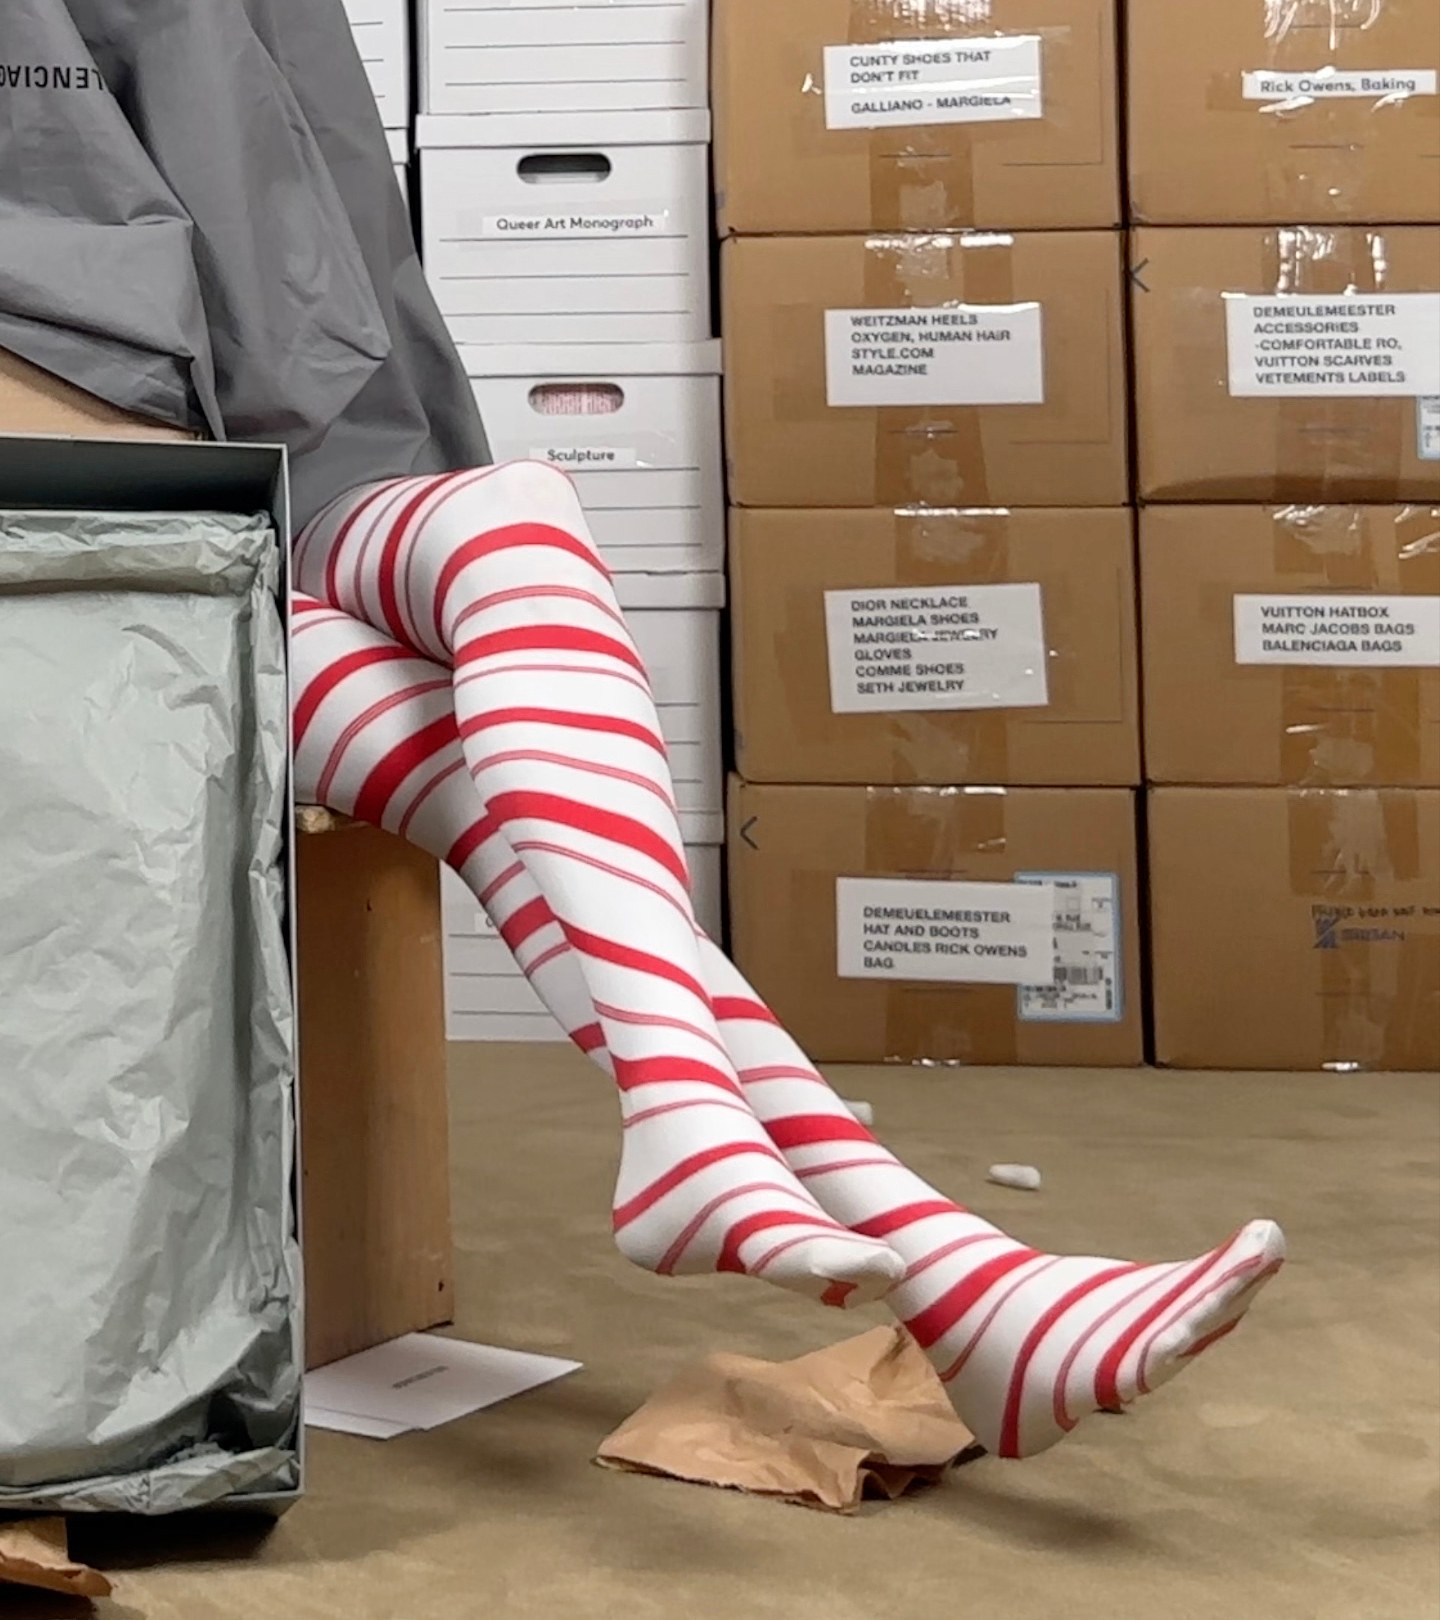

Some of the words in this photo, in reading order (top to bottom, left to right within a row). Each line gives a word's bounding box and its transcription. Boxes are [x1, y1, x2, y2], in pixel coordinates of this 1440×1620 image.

[850, 54, 898, 68] CUNTY
[902, 52, 952, 65] SHOES
[956, 50, 991, 63] THAT
[850, 70, 894, 83] DON'T
[898, 69, 919, 81] FIT
[1261, 80, 1293, 93] Rick
[1298, 80, 1356, 93] Owens,
[1361, 77, 1416, 92] Baking
[851, 99, 923, 114] GALLIANO
[936, 96, 1011, 109] MARGIELA
[496, 217, 540, 231] Queer
[544, 217, 566, 230] Art
[569, 214, 654, 231] Monograph
[1253, 304, 1396, 318] DEMEULEMEESTER
[850, 315, 927, 327] WEITZMAN
[931, 314, 979, 326] HEELS
[1253, 321, 1359, 334] ACCESSORIES
[851, 332, 915, 344] OXYGEN,
[919, 330, 972, 342] HUMAN
[976, 329, 1011, 341] HAIR
[851, 347, 934, 360] STYLE.COM
[1254, 355, 1319, 367] VUITTON
[1323, 354, 1393, 367] SCARVES
[852, 363, 928, 376] MAGAZINE
[1256, 371, 1345, 384] VETEMENTS
[1349, 370, 1406, 383] LABELS
[546, 448, 615, 464] Sculpture
[851, 600, 886, 612] DIOR
[890, 596, 968, 609] NECKLACE
[1260, 606, 1325, 618] VUITTON
[1329, 606, 1389, 618] HATBOX
[852, 613, 927, 628] MARGIELA
[930, 612, 979, 625] SHOES
[1262, 623, 1306, 635] MARC
[1310, 623, 1370, 635] JACOBS
[1374, 623, 1415, 635] BAGS
[853, 630, 928, 644] MARGIELA
[1262, 640, 1358, 652] BALENCIAGA
[1361, 640, 1402, 652] BAGS
[854, 648, 912, 661] GLOVES
[855, 664, 911, 677] COMME
[915, 662, 964, 675] SHOES
[857, 682, 894, 694] SETH
[898, 679, 964, 693] JEWELRY
[864, 906, 1011, 923] DEMEUELEMEESTER
[863, 924, 890, 936] HAT
[894, 925, 926, 938] AND
[929, 926, 979, 939] BOOTS
[863, 940, 931, 954] CANDLES
[935, 942, 970, 955] RICK
[974, 944, 1027, 958] OWENS
[864, 956, 894, 969] BAG
